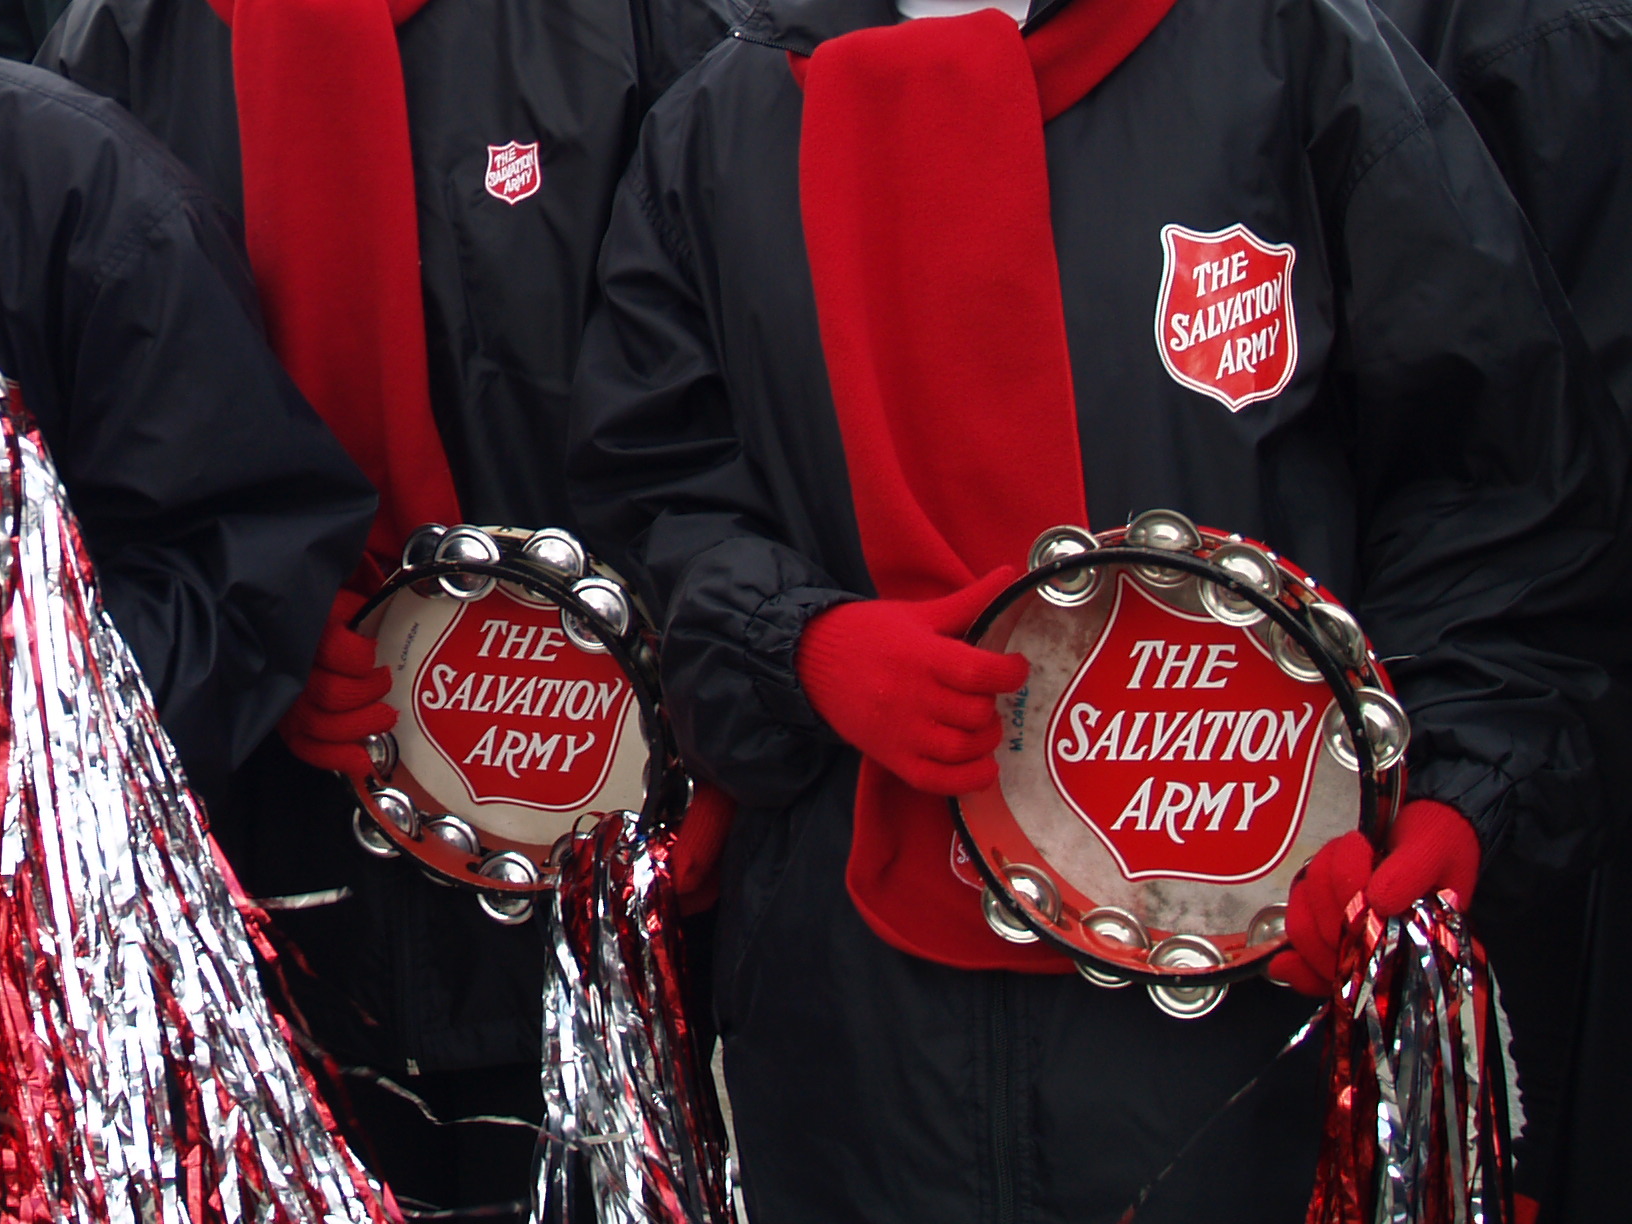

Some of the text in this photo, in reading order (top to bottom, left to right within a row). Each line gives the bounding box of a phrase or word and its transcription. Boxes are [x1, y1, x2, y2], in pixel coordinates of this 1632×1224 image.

[488, 149, 534, 187] SALVATION
[494, 147, 517, 168] THE
[503, 168, 533, 195] ARMY
[1193, 250, 1249, 298] THE
[1170, 271, 1283, 352] SALVATION
[1215, 318, 1281, 380] ARMY
[477, 619, 566, 662] THE
[1126, 639, 1239, 689] THE
[421, 663, 623, 721] SALVATION
[462, 725, 595, 779] ARMY
[1057, 702, 1314, 763] SALVATION
[1109, 776, 1280, 844] ARMY
